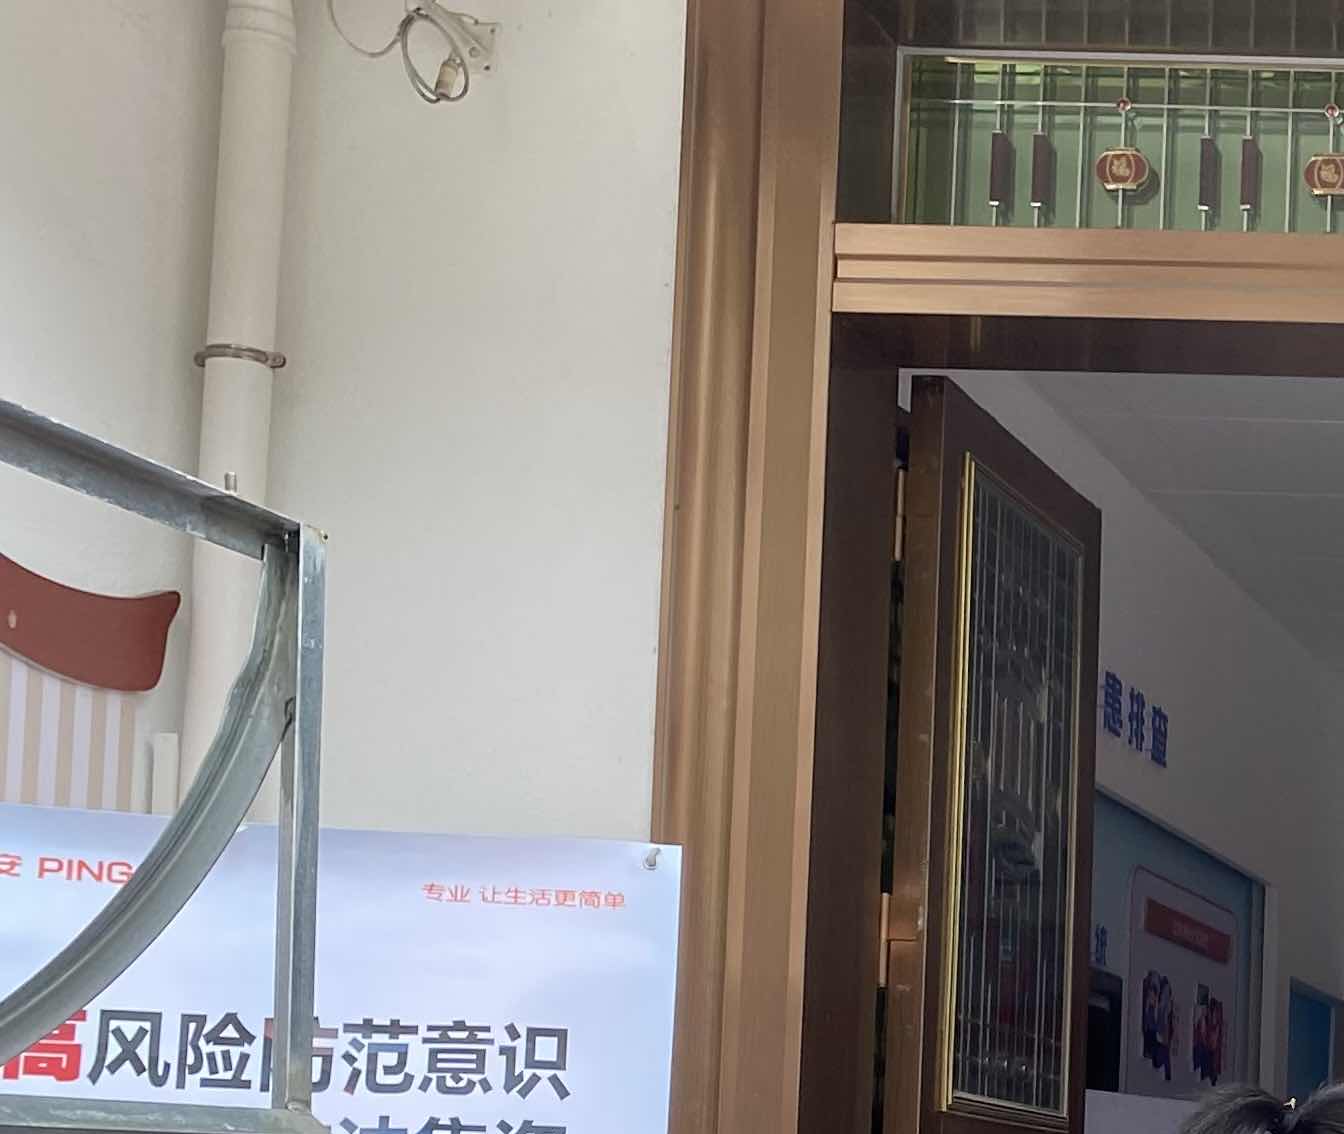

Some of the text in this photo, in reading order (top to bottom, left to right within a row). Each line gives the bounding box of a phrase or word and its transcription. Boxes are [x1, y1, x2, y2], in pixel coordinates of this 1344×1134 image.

[37, 856, 133, 884] PING
[422, 883, 625, 910] 专业 让生活更简单
